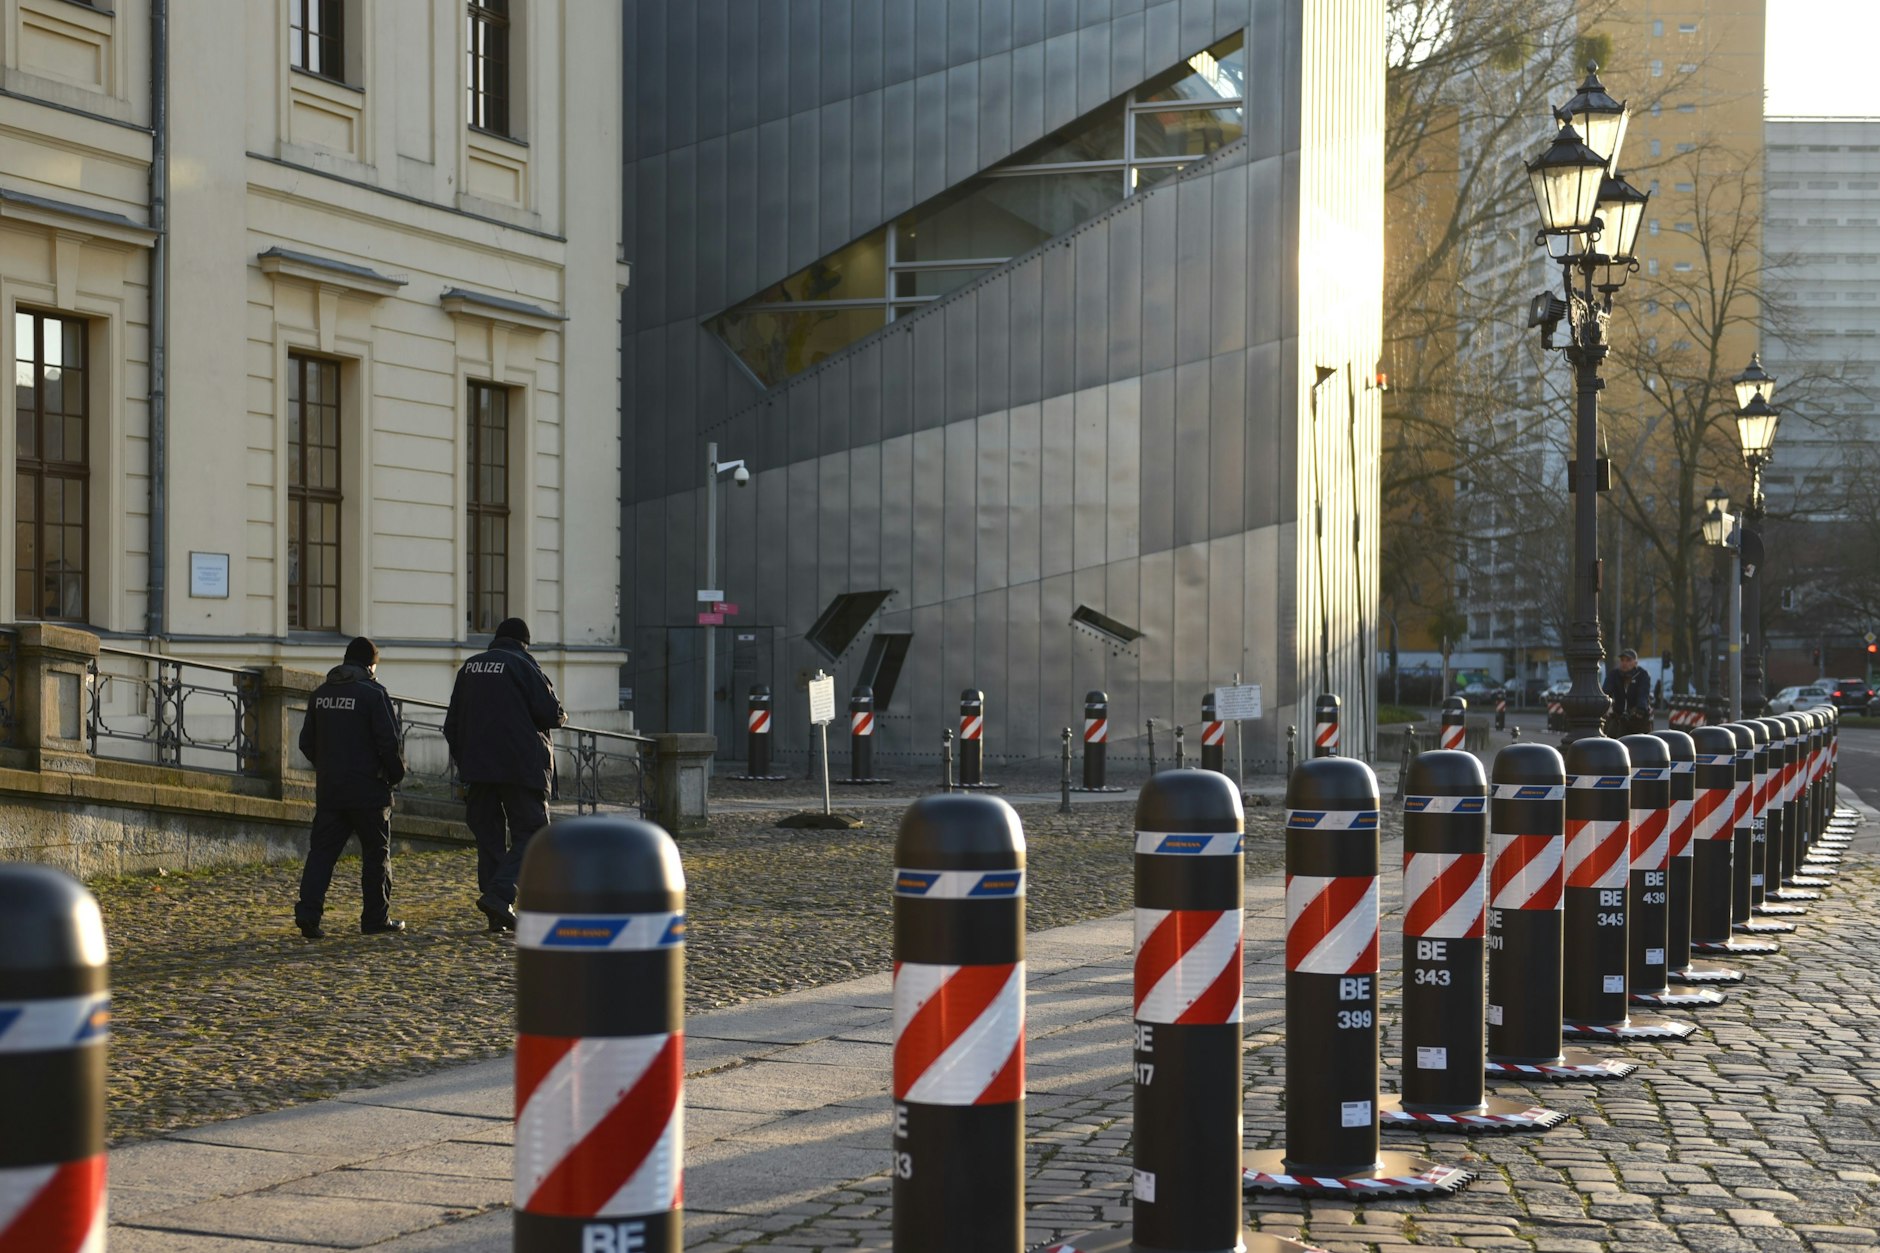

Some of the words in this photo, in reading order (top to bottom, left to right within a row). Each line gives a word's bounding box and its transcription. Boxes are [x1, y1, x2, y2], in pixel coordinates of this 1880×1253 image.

[465, 662, 504, 673] POLIZEI
[316, 697, 355, 710] POLIZEI
[1645, 871, 1664, 886] BE
[1600, 890, 1622, 906] BE
[1642, 892, 1665, 904] 439
[1597, 912, 1624, 926] 345
[1417, 940, 1447, 960] BE
[1414, 968, 1451, 986] 343
[1340, 977, 1370, 1000] BE
[1337, 1010, 1372, 1029] 399
[582, 1222, 646, 1253] BE
